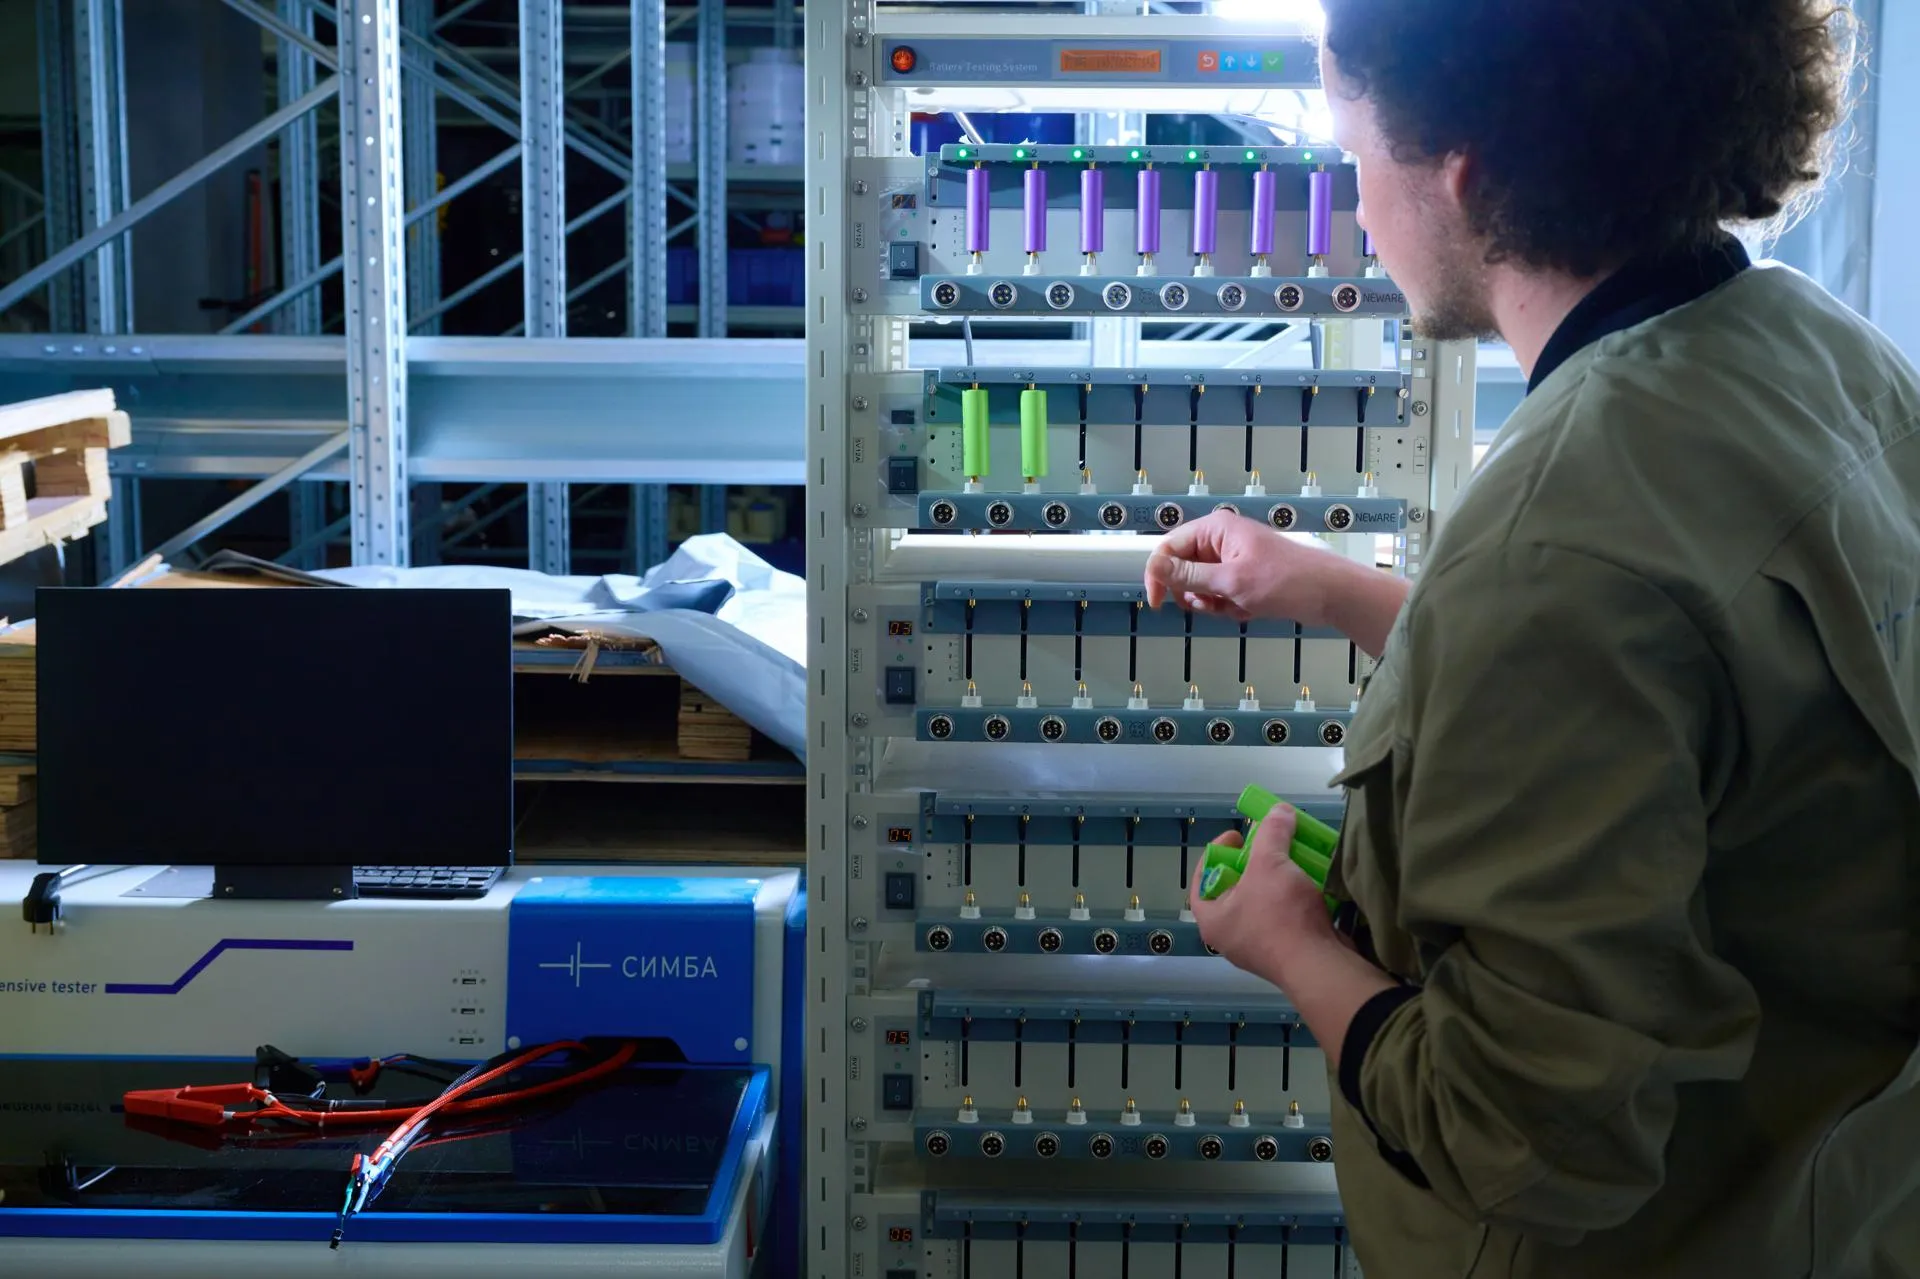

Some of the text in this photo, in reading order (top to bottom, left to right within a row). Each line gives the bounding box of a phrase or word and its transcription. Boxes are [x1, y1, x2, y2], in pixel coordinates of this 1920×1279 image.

[929, 61, 1038, 74] Battery Testing System
[1364, 293, 1404, 304] NEWARE
[1355, 512, 1396, 523] NEWARE
[889, 621, 912, 635] 03
[889, 828, 912, 842] 04
[622, 956, 718, 978] СИМБА
[0, 979, 97, 994] ensive tester
[888, 1031, 909, 1044] 05
[890, 1228, 911, 1242] 06
